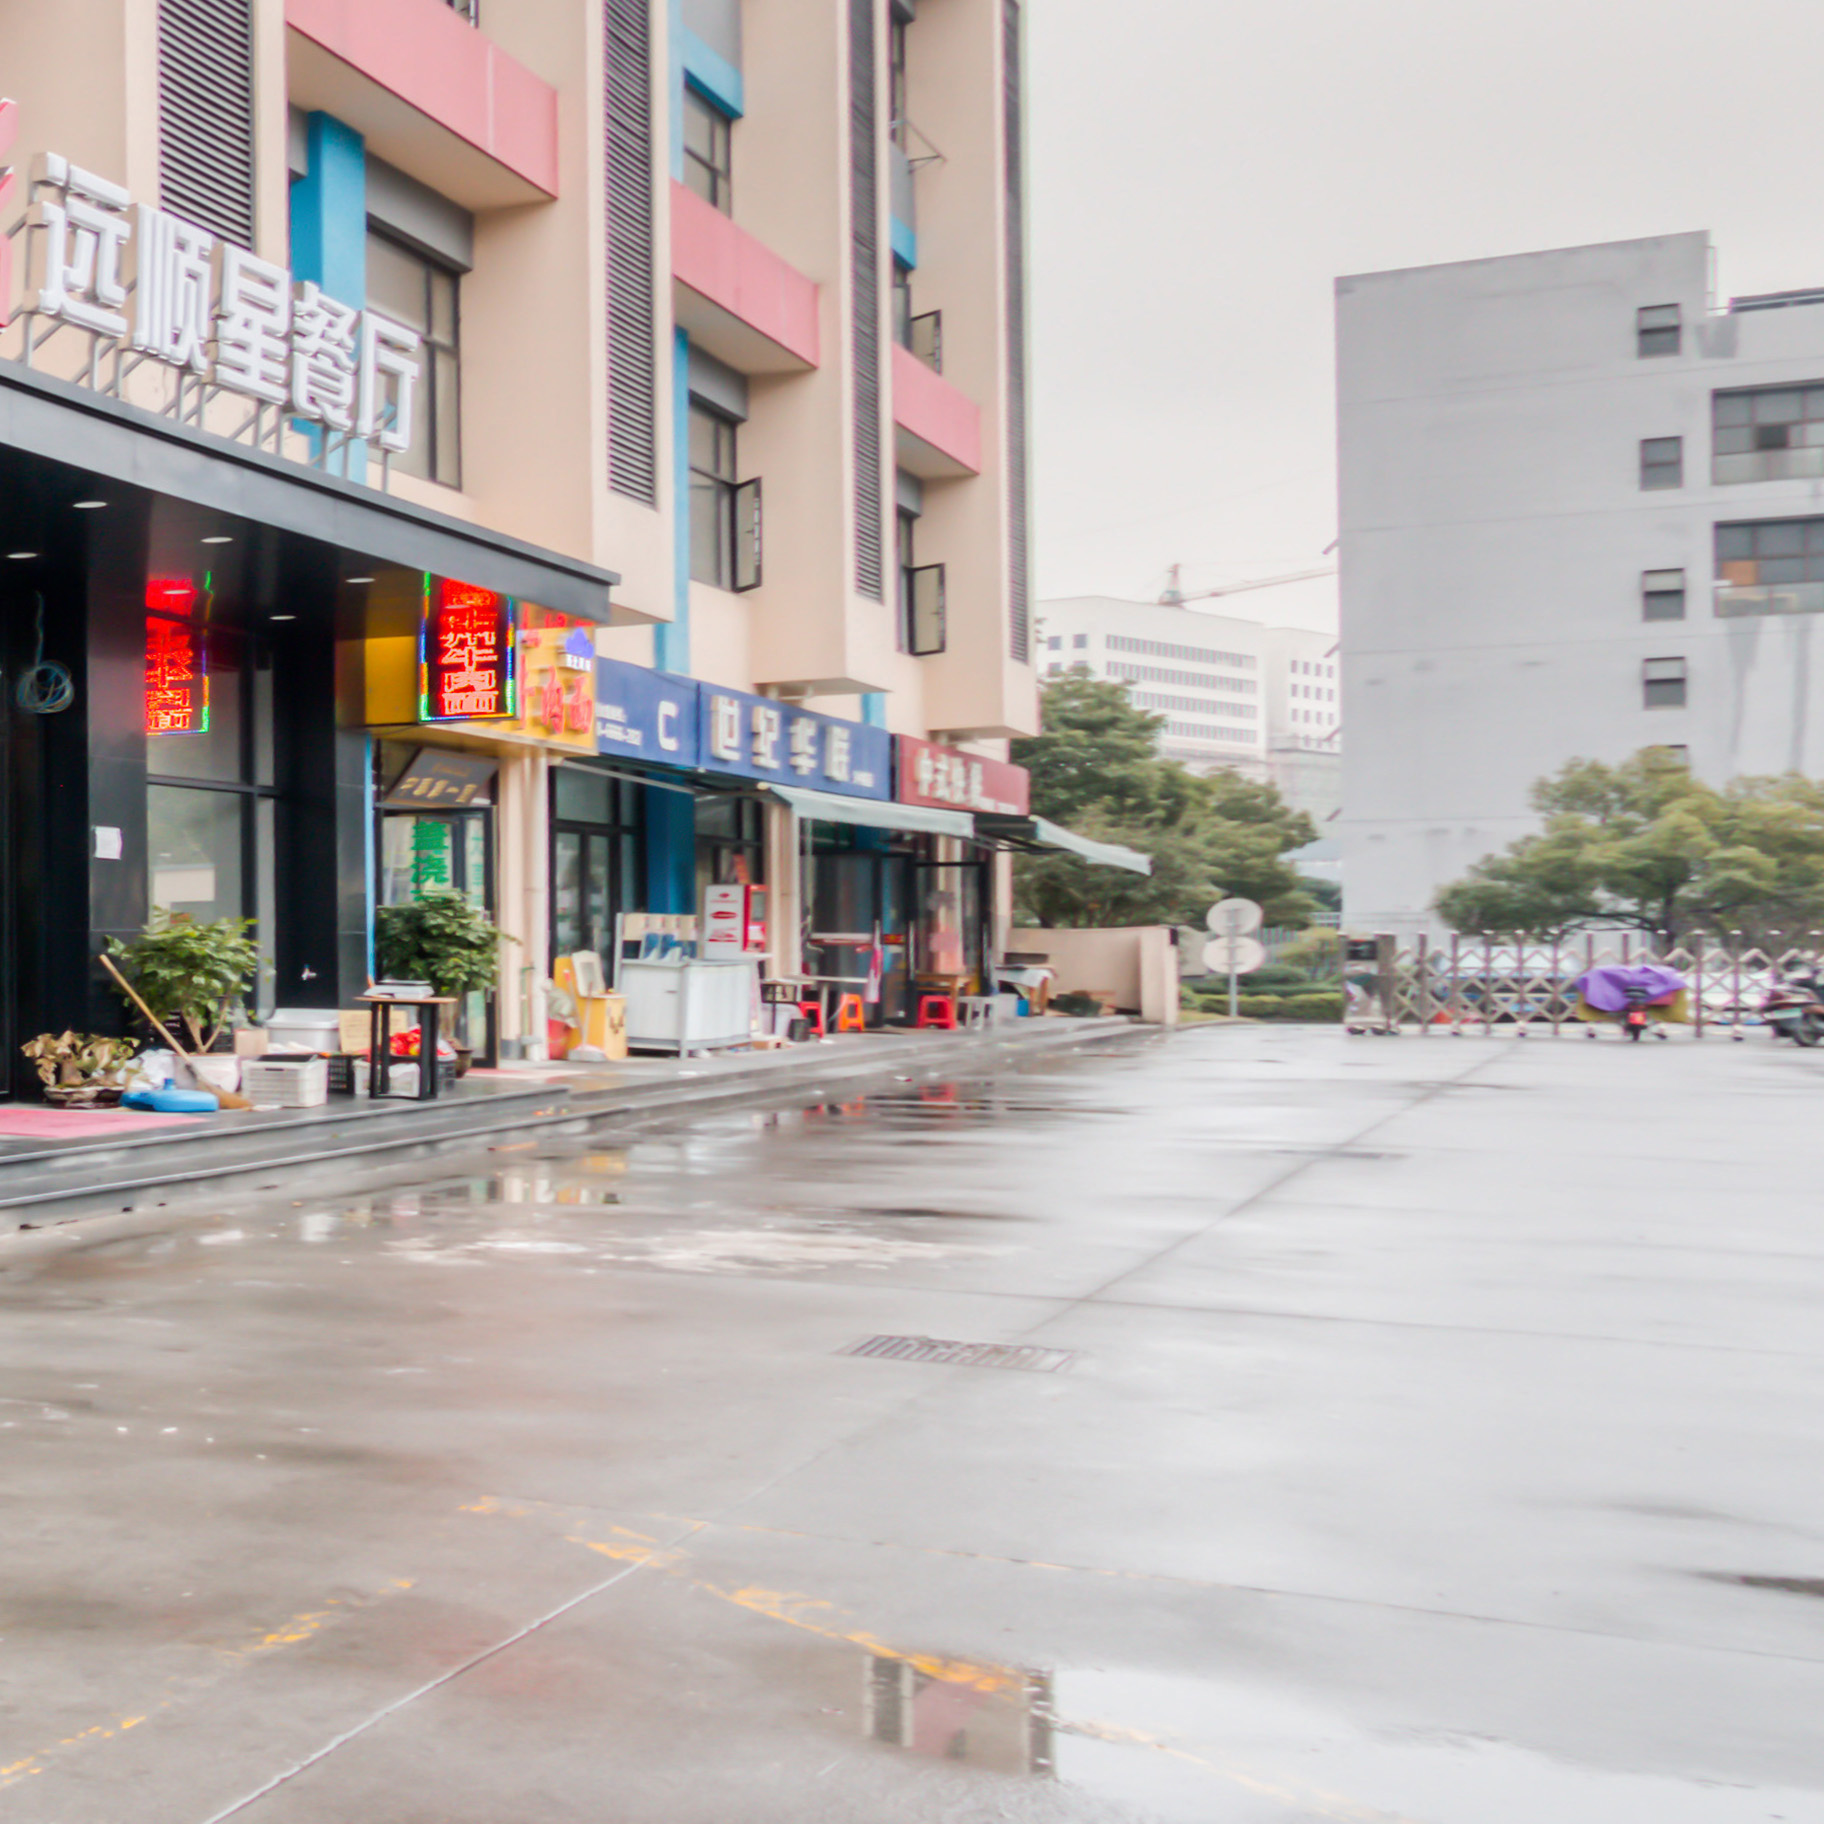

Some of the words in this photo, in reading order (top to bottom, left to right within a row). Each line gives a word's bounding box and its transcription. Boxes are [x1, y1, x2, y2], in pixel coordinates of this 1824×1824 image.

[28, 151, 420, 453] 远顺星餐厅
